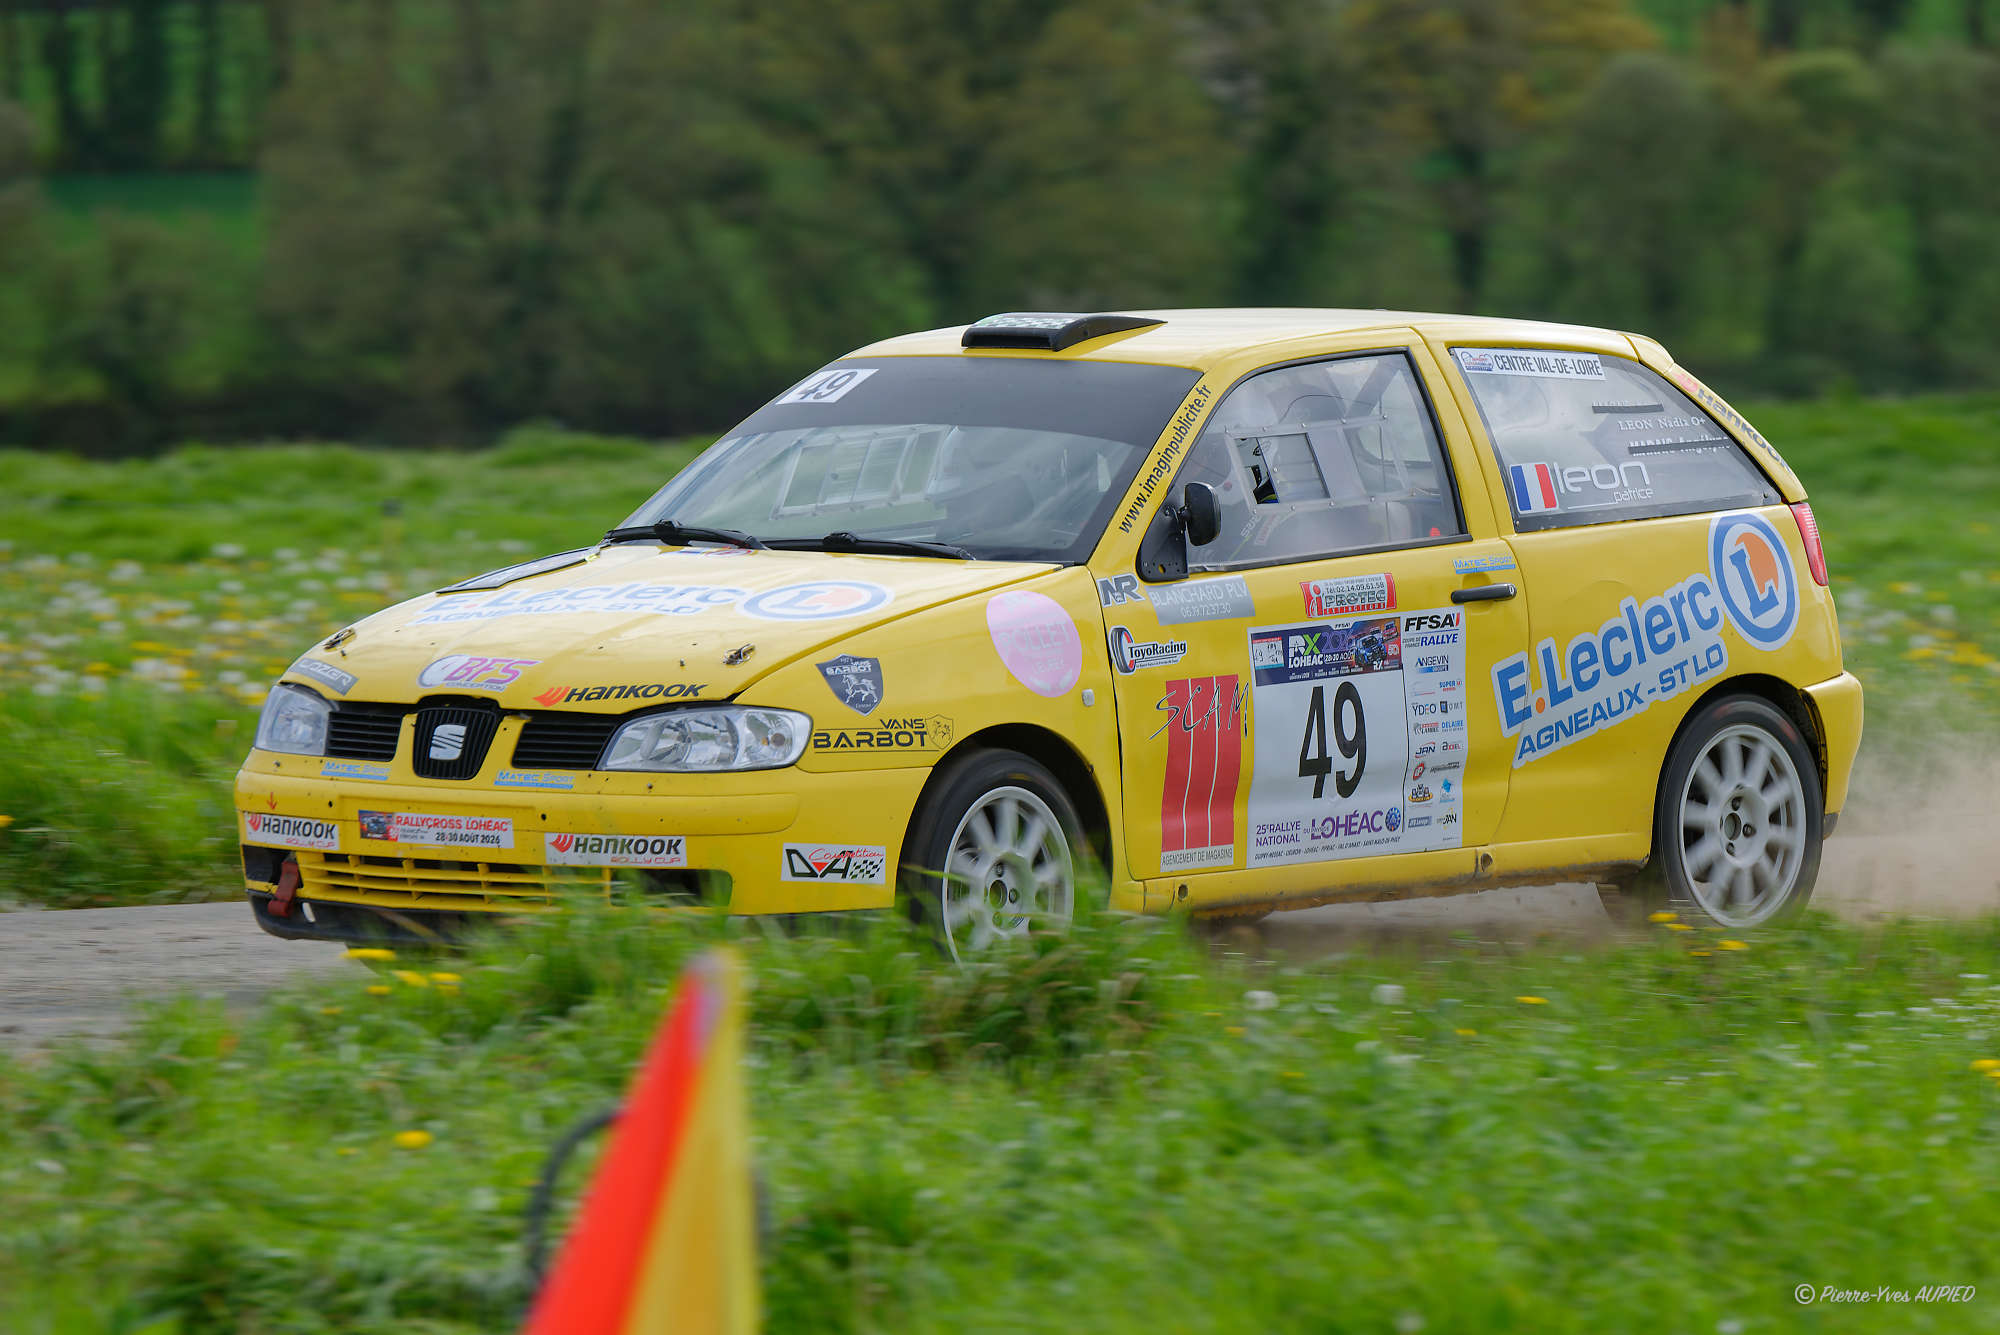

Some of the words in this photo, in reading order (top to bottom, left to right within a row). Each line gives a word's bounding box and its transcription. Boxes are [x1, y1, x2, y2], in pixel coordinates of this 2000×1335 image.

[1493, 354, 1536, 373] CENTRE
[1533, 356, 1603, 376] VAL-DE-LOIRE
[797, 371, 858, 400] 49
[1618, 419, 1653, 431] LEON
[1118, 384, 1213, 534] www.imaginpublicite.fr
[1553, 461, 1650, 494] leon
[424, 582, 746, 613] E.Leclerc
[1099, 574, 1146, 606] NR
[1149, 584, 1224, 607] BLANCHARD
[1225, 581, 1249, 598] PLV
[1405, 613, 1455, 632] FFSA
[1128, 640, 1187, 659] ToyoRacing
[1421, 633, 1459, 647] RALLYE
[1288, 653, 1324, 669] LOHEAC
[1416, 655, 1449, 667] ANGEVIN
[1497, 581, 1720, 729] E.Leclerc
[444, 656, 540, 684] BFS
[826, 664, 872, 676] BARBOT
[1149, 682, 1249, 740] SCAM
[879, 718, 925, 729] VANS
[1518, 682, 1644, 760] AGNEAUX
[813, 731, 927, 748] BARBOT
[1299, 681, 1367, 799] 49
[498, 771, 539, 782] MATEC
[395, 814, 462, 830] RALLYCROSS
[1268, 820, 1301, 834] RALLYE
[1310, 810, 1384, 841] LOHÉAC
[480, 832, 500, 844] 2026
[1255, 833, 1301, 847] NATIONAL
[1161, 852, 1197, 866] AGENCEMENT
[1197, 850, 1206, 861] DE
